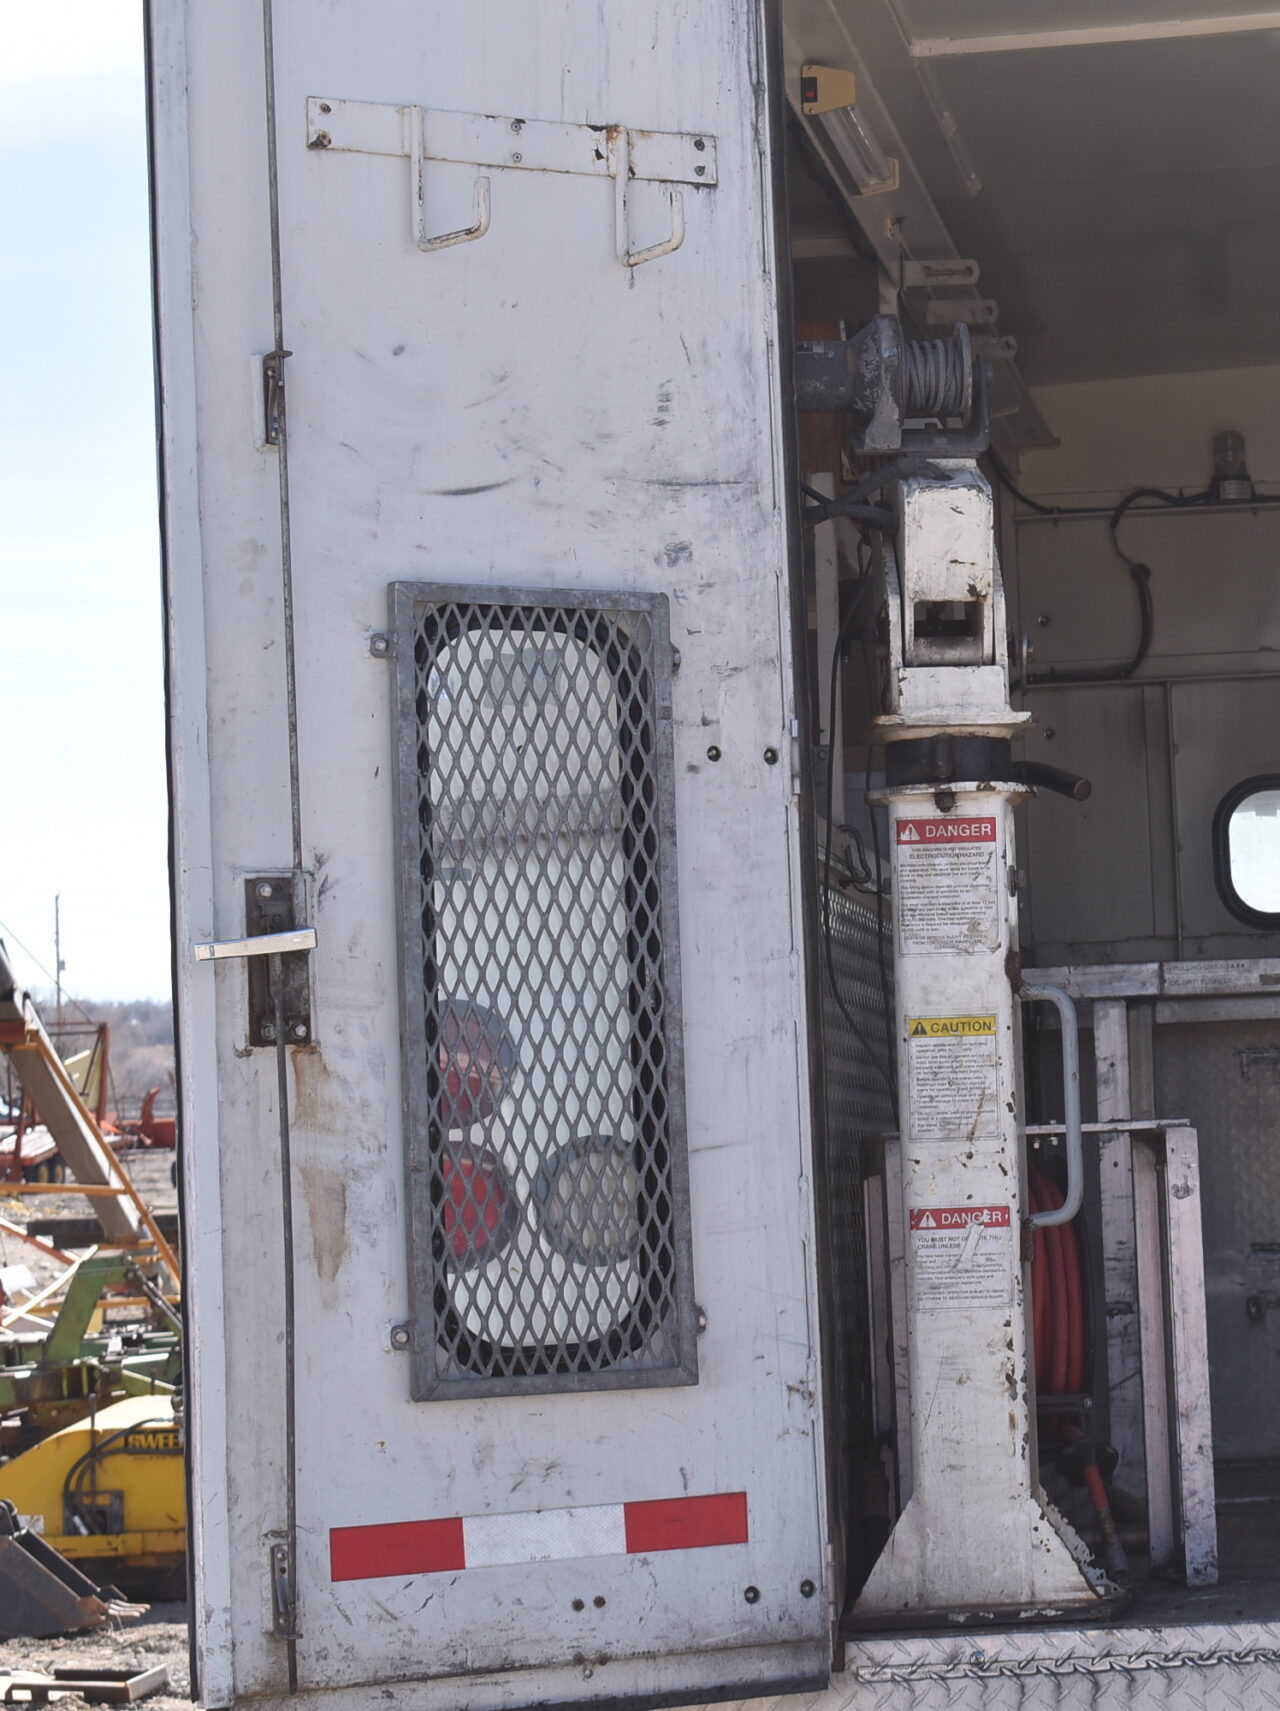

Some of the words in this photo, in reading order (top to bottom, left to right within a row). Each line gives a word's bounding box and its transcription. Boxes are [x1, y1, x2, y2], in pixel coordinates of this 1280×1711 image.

[925, 823, 992, 838] DANGER
[930, 1021, 992, 1033] CAUTION
[941, 1210, 1002, 1225] DANGER
